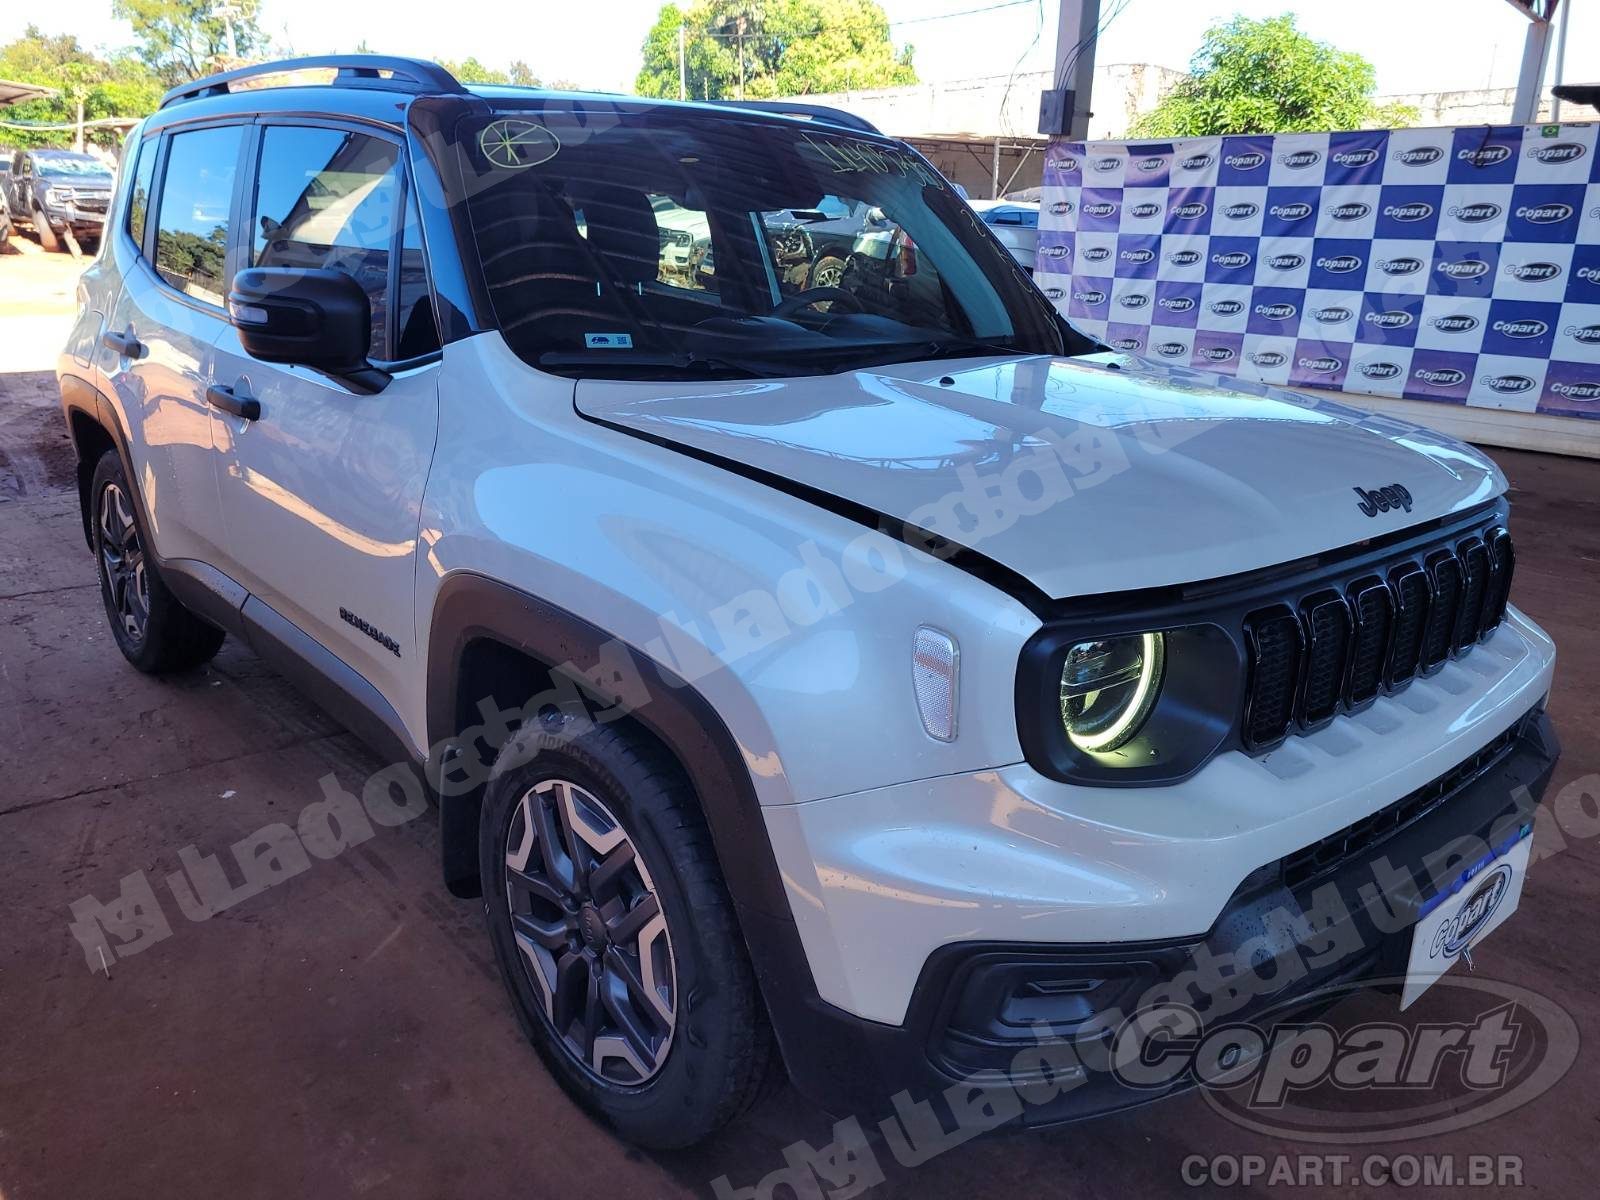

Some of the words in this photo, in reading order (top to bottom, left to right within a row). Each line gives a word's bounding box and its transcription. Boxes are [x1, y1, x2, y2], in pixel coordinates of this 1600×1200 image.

[1332, 152, 1374, 163] Copart
[1392, 151, 1438, 162] Copart
[1527, 147, 1578, 160] Copart
[1224, 156, 1260, 167] Copart
[1278, 154, 1315, 165] Copart
[1083, 204, 1113, 214] Copart
[1170, 205, 1202, 215] Copart
[1218, 205, 1254, 216] Copart
[1270, 205, 1307, 216] Copart
[1326, 205, 1364, 216] Copart
[1384, 205, 1427, 217] Copart
[1447, 206, 1494, 217] Copart
[1516, 206, 1567, 219] Copart
[1039, 247, 1066, 256] Copart
[1120, 250, 1150, 260] Copart
[1212, 254, 1246, 264] Copart
[1264, 256, 1299, 267] Copart
[1316, 258, 1356, 268] Copart
[1375, 260, 1417, 271] Copart
[1437, 262, 1483, 274] Copart
[1504, 264, 1554, 277] Copart
[1074, 292, 1102, 302] Copart
[1159, 298, 1190, 308] Copart
[1207, 302, 1240, 312] Copart
[1255, 305, 1292, 316] Copart
[1308, 308, 1347, 319] Copart
[1365, 312, 1407, 323] Copart
[1427, 318, 1472, 329] Copart
[1493, 321, 1541, 334] Copart
[1109, 339, 1139, 349] Copart
[1152, 343, 1183, 352] Copart
[1198, 347, 1230, 359] Copart
[1246, 353, 1281, 364] Copart
[1299, 358, 1336, 369] Copart
[1355, 363, 1395, 374] Copart
[1415, 369, 1460, 381] Copart
[1480, 376, 1528, 388] Copart
[1352, 483, 1413, 517] Jeep
[1429, 874, 1506, 959] Copart
